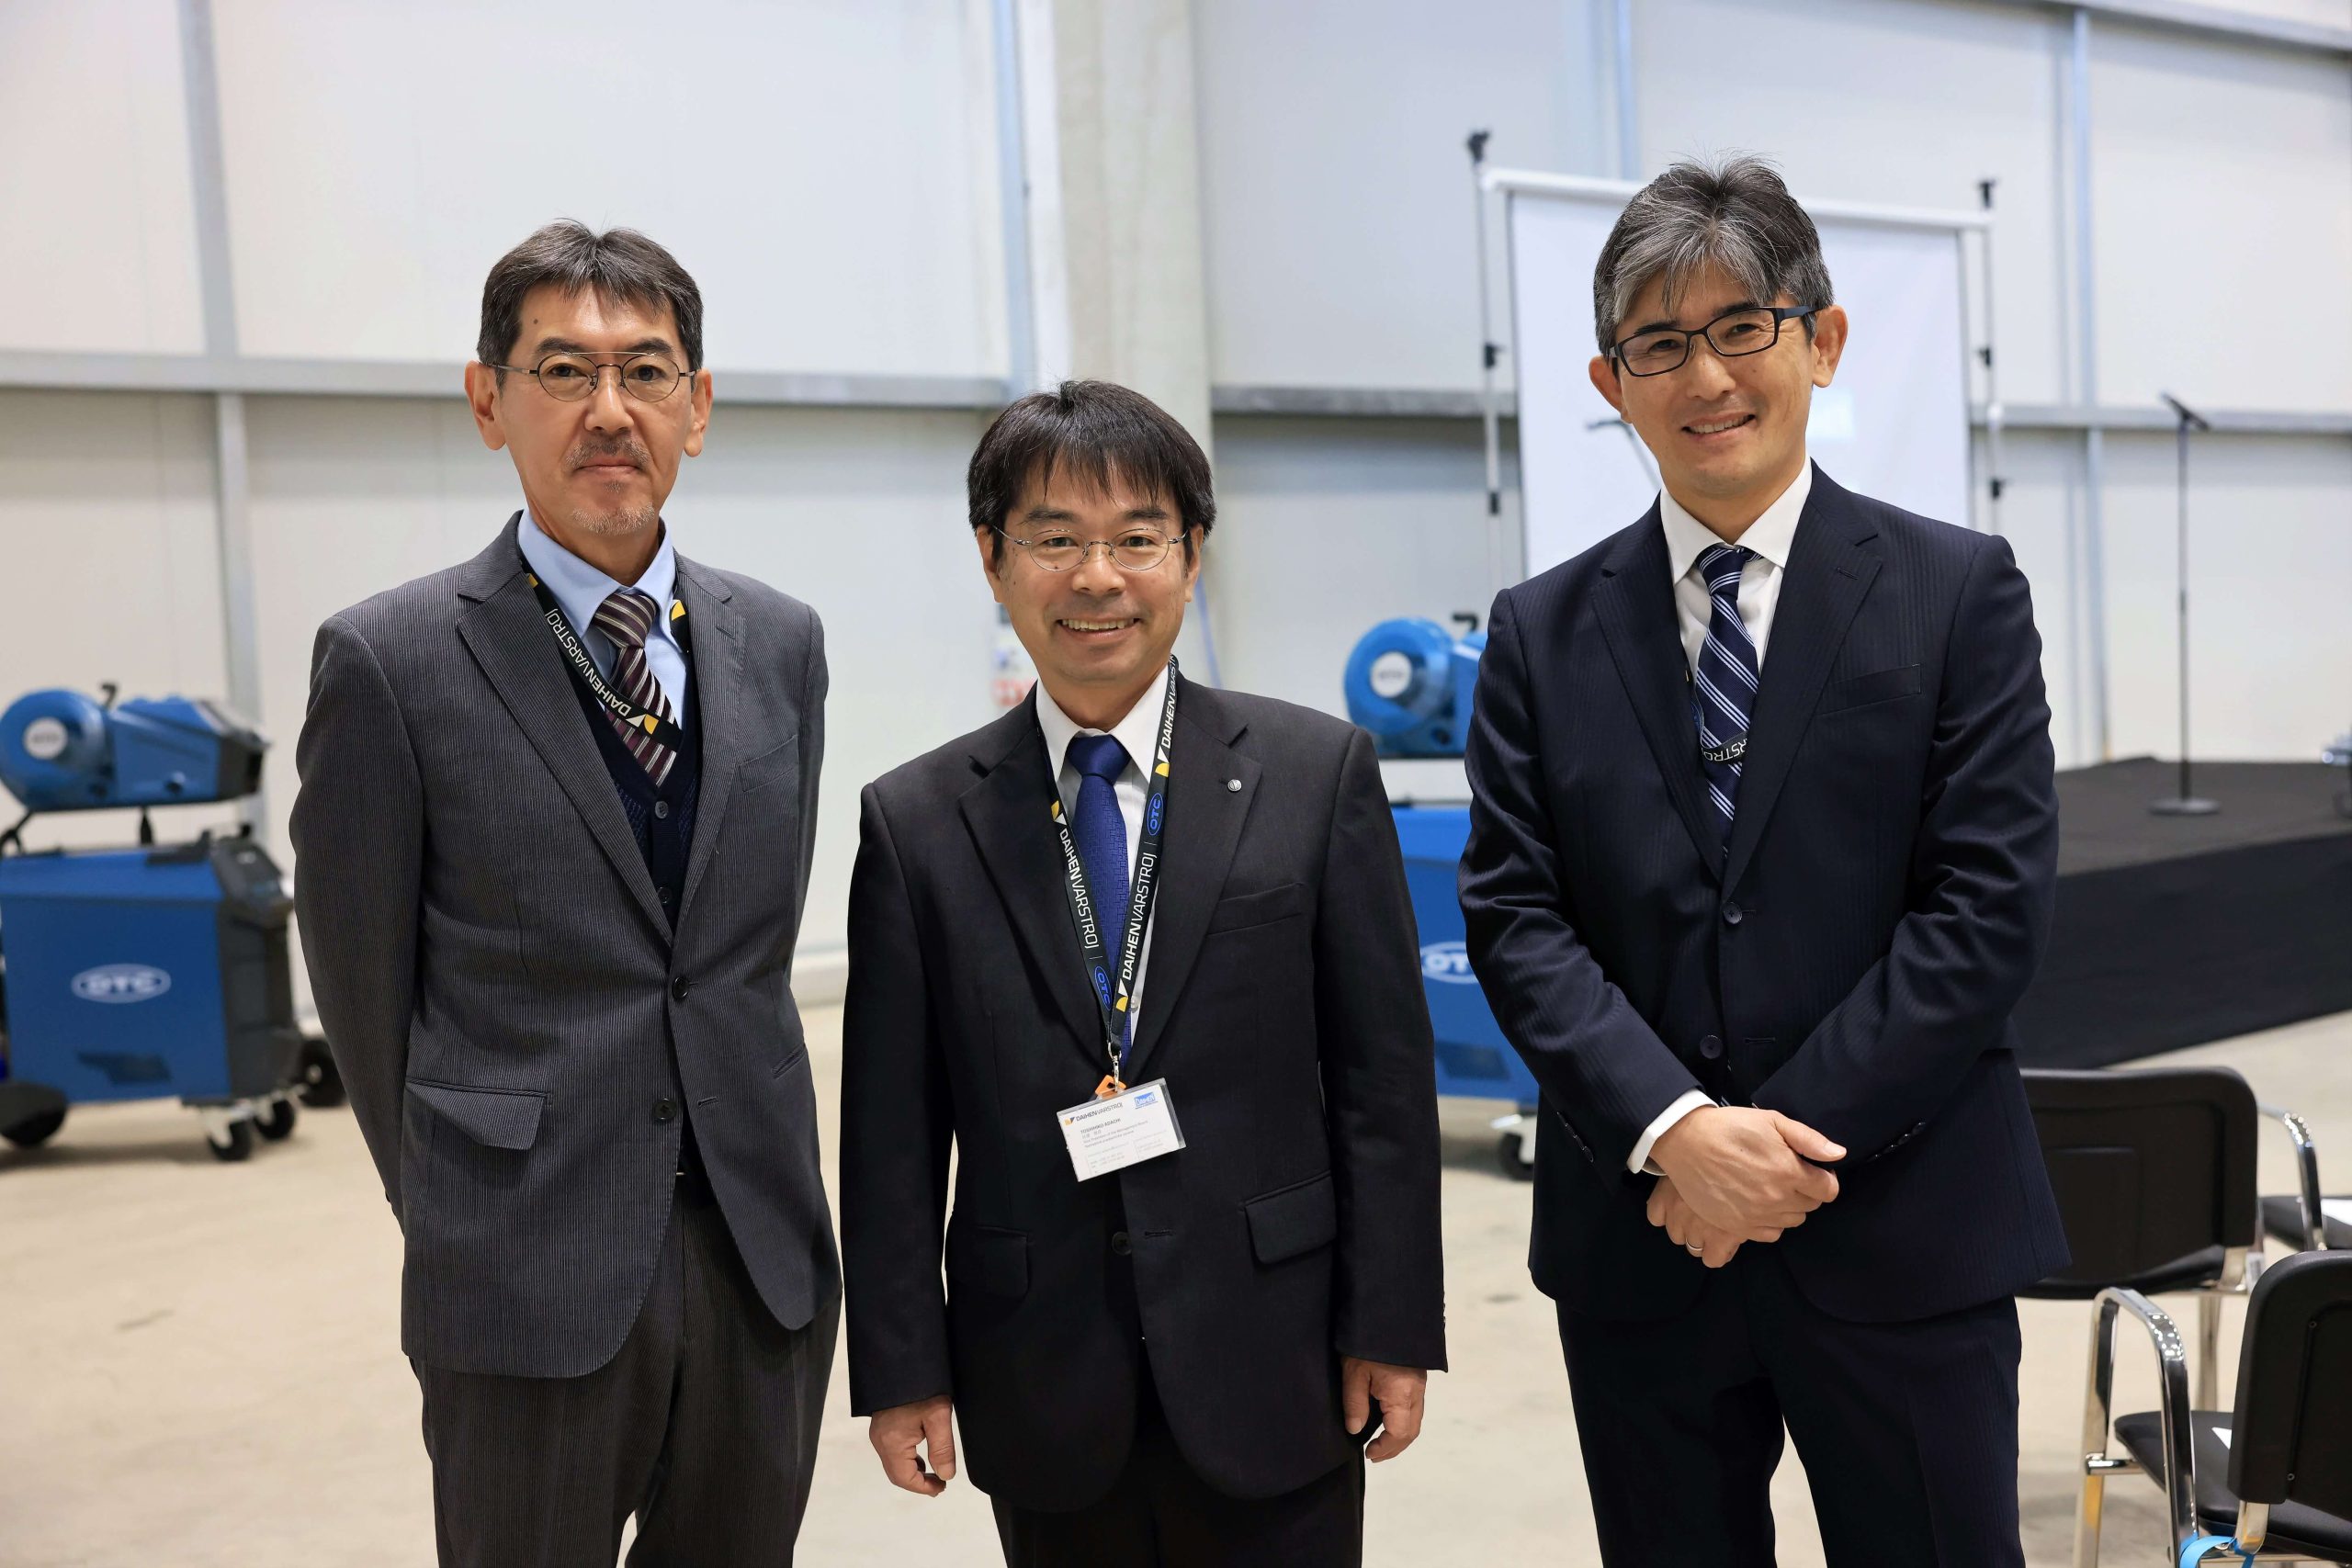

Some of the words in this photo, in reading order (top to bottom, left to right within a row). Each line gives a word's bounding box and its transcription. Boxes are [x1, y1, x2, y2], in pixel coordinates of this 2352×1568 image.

[545, 608, 632, 716] DAIHENVARSTROJ
[1149, 798, 1161, 830] OTC
[1059, 828, 1100, 949] DAIHENVARSTROJ
[1123, 852, 1158, 981] DAIHENVARSTROJ
